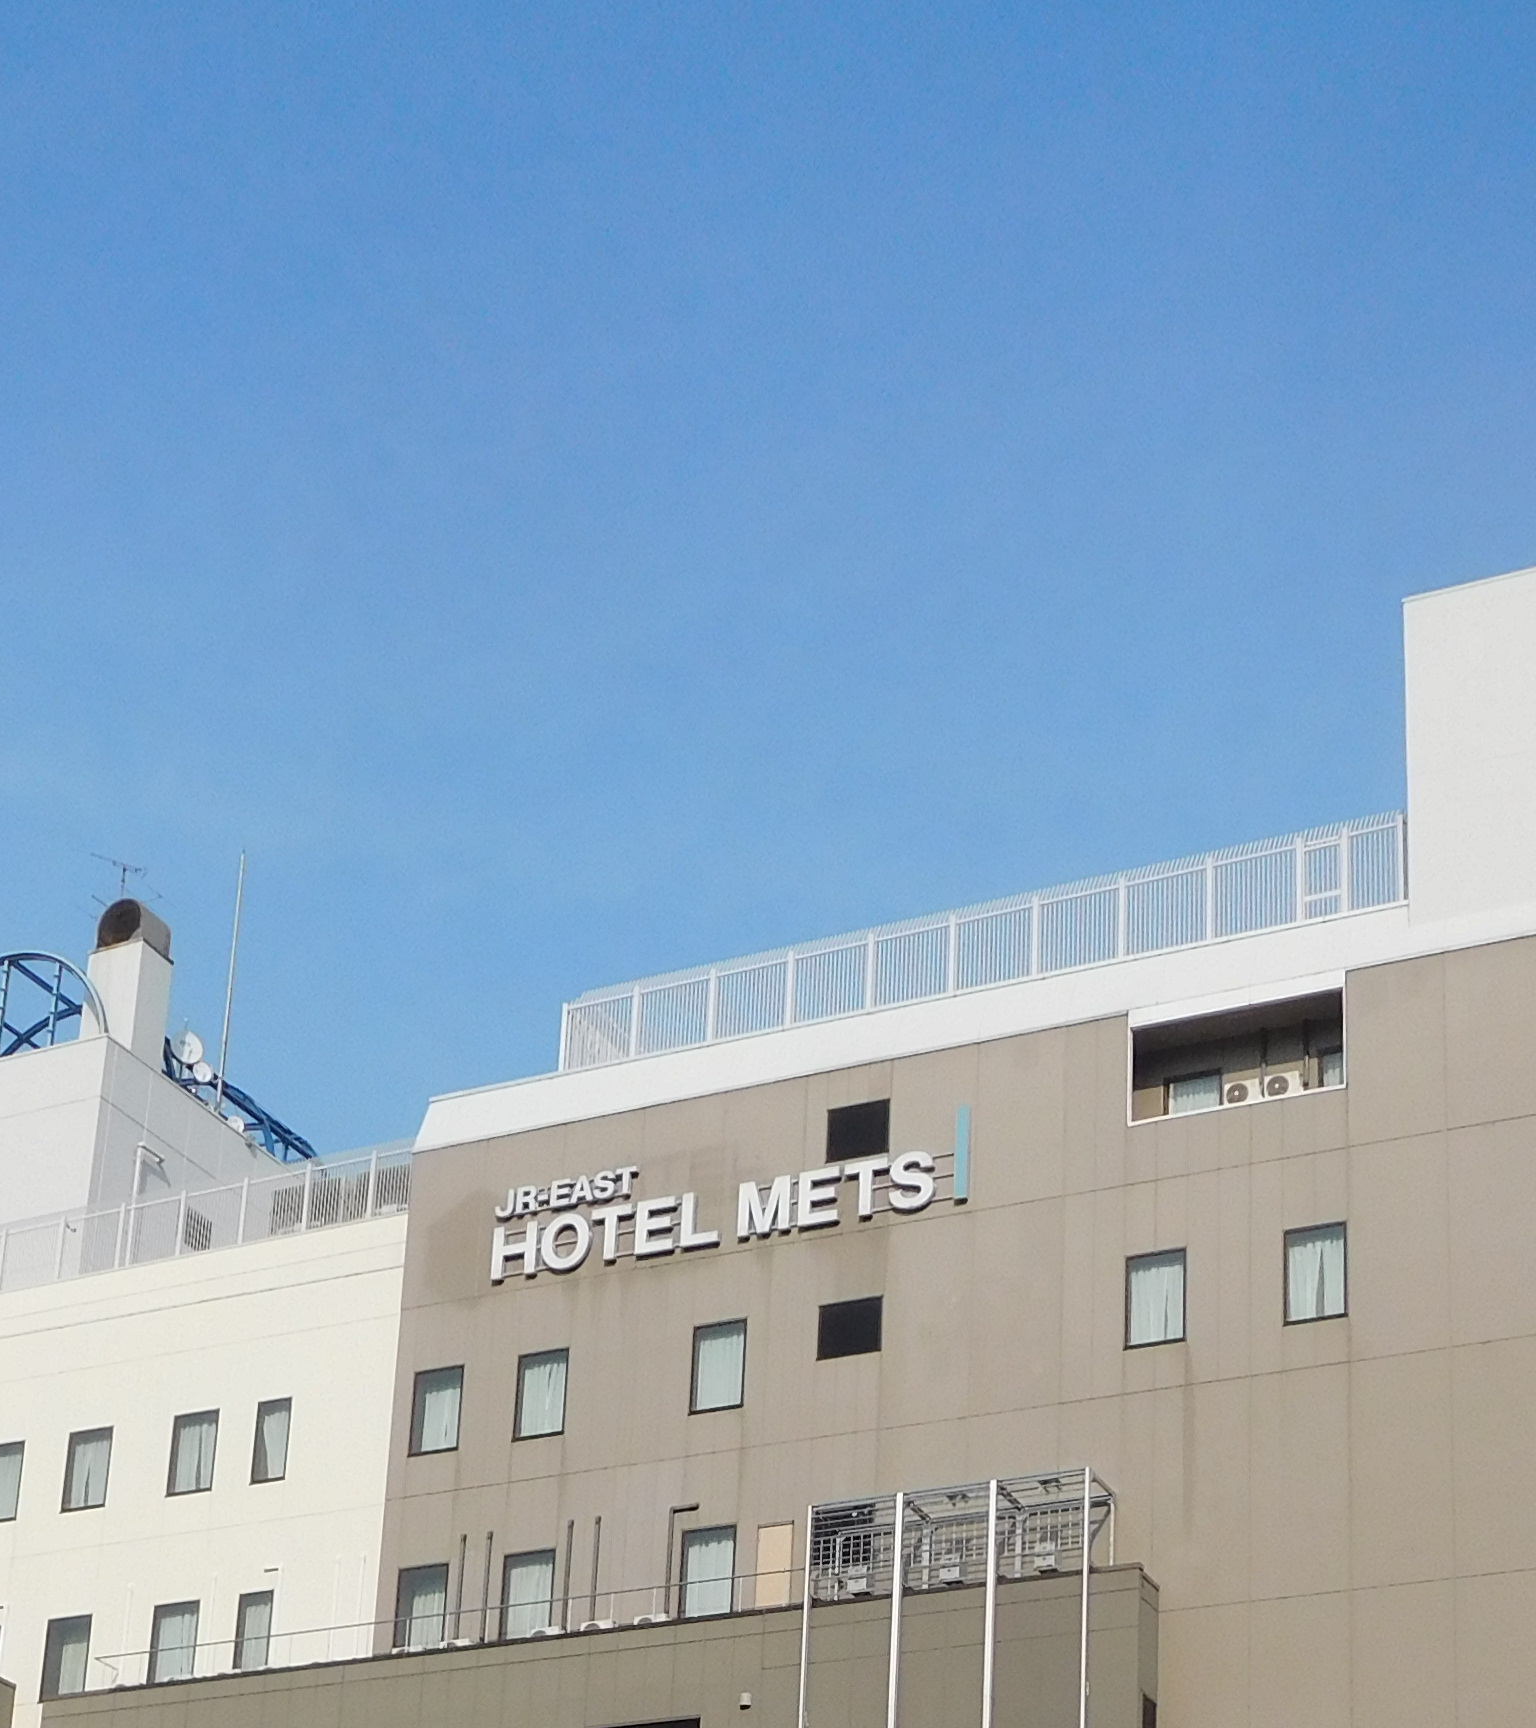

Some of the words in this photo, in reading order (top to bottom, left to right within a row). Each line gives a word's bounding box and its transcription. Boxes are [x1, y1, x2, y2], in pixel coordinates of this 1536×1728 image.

[490, 1191, 721, 1284] HOTEL
[736, 1149, 938, 1244] METS
[495, 1165, 639, 1222] JR-EAST
